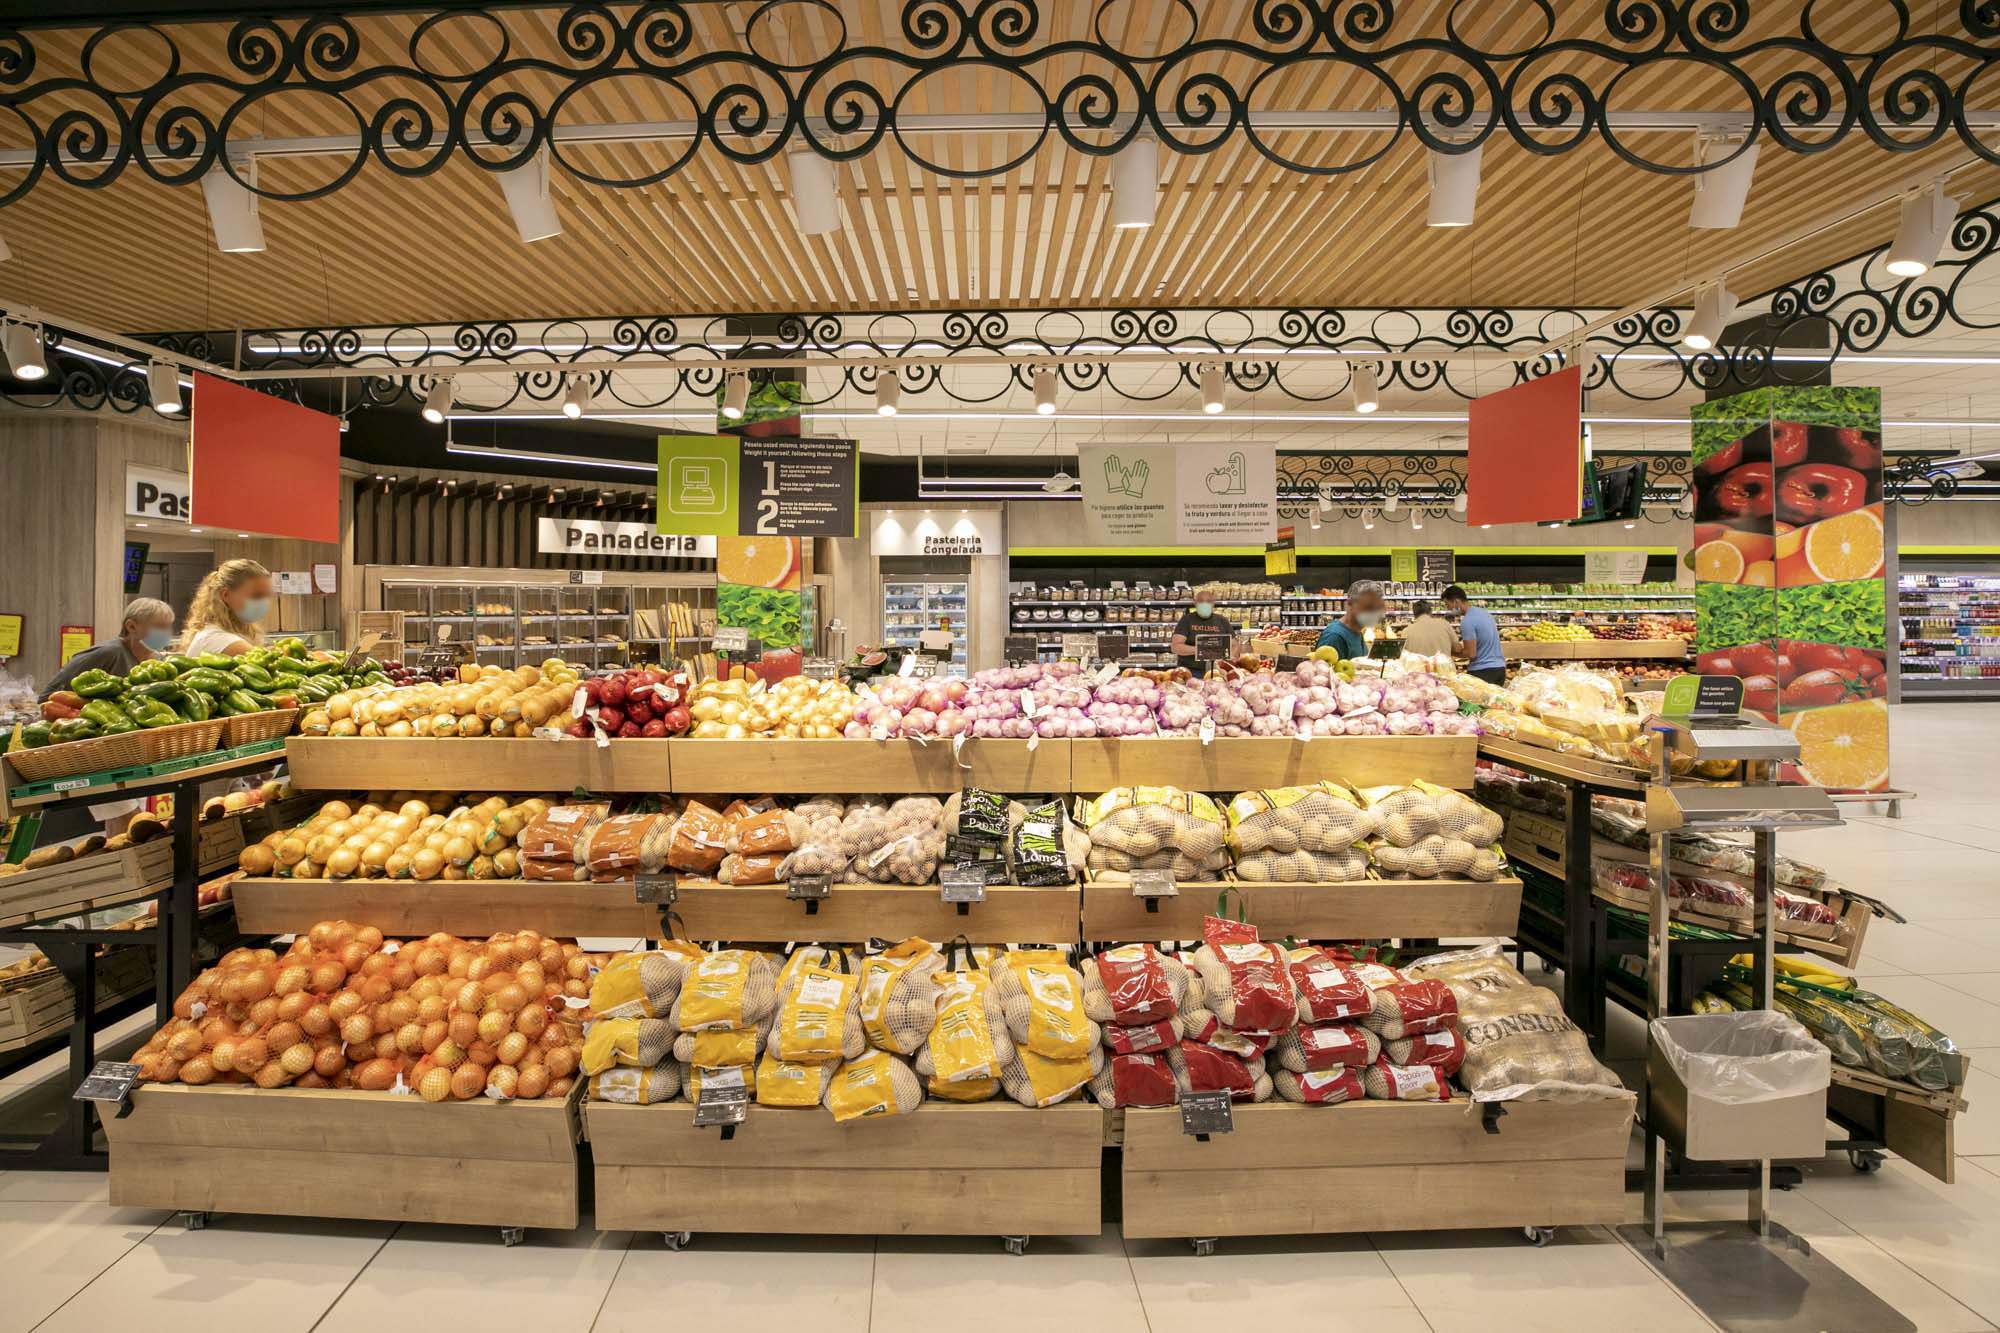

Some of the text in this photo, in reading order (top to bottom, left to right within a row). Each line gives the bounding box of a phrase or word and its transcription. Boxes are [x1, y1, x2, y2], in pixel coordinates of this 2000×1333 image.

[761, 461, 780, 496] 1
[757, 498, 778, 534] 2
[923, 545, 982, 554] Congelada
[1423, 556, 1430, 569] 1
[1422, 569, 1430, 581] 2
